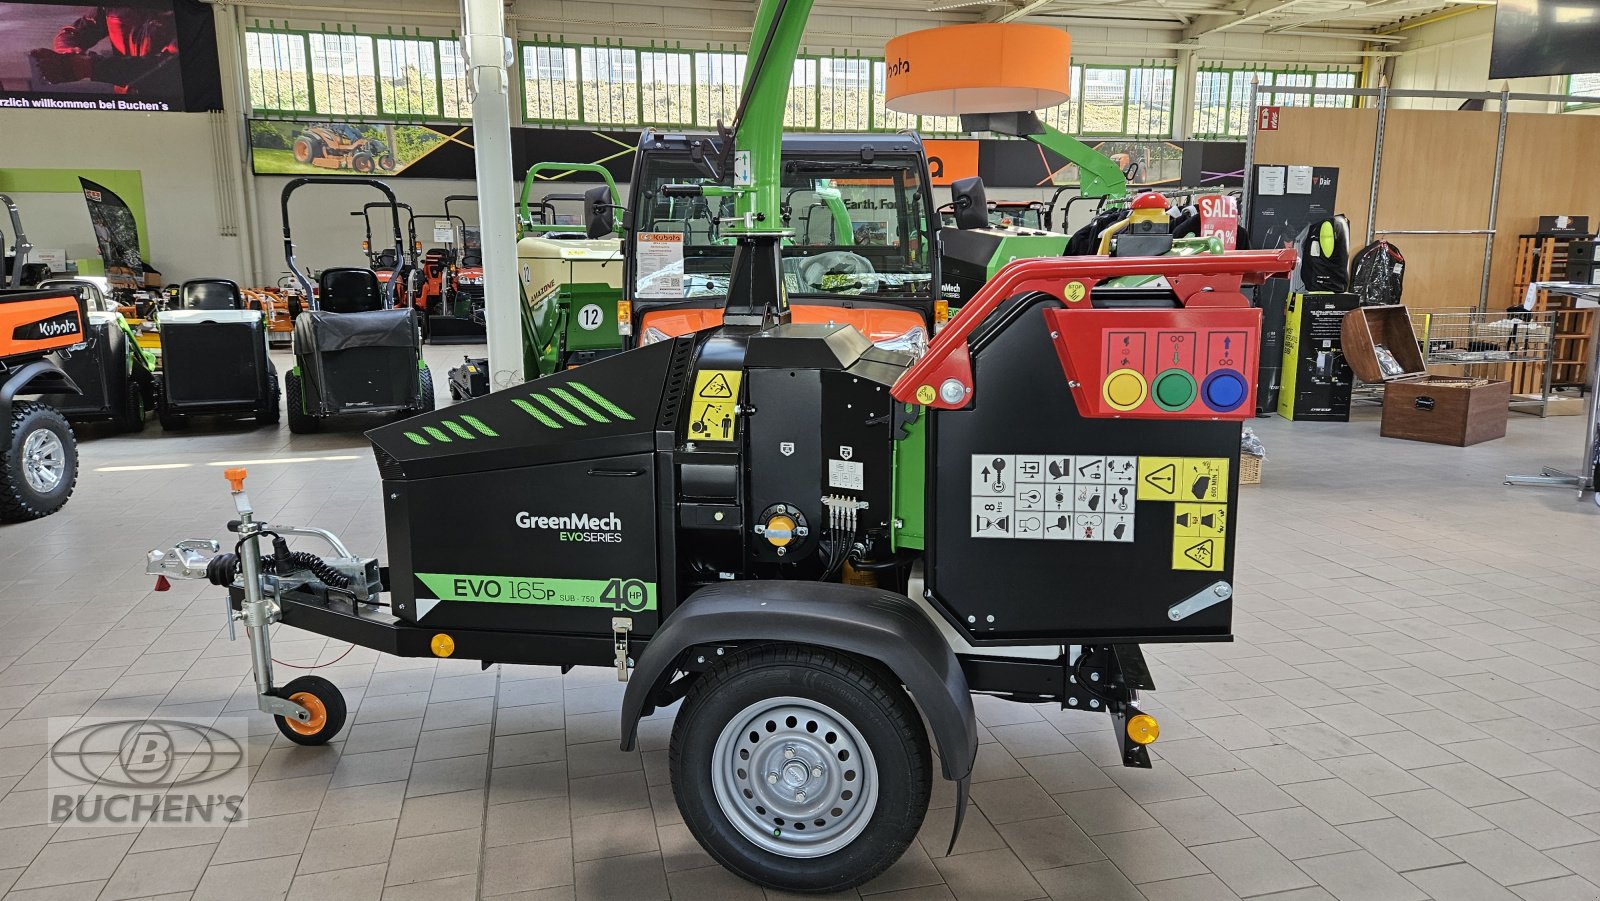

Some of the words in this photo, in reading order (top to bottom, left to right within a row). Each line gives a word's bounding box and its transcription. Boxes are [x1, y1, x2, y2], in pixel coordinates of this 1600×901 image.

[32, 98, 97, 109] willkommen
[99, 100, 116, 110] bei
[846, 198, 878, 210] Earth,
[880, 198, 899, 210] Fo
[1201, 199, 1237, 218] SALE
[653, 233, 681, 241] Kubota
[523, 266, 530, 282] 12
[530, 279, 556, 303] AMAZONE
[583, 308, 599, 326] 12
[39, 319, 77, 336] Kubota
[515, 511, 622, 531] GreenMech
[560, 531, 622, 543] EVOSERIES
[453, 578, 501, 599] EVO
[559, 594, 576, 602] SUB
[581, 595, 595, 603] 750
[599, 578, 648, 611] 40
[629, 591, 642, 600] HP
